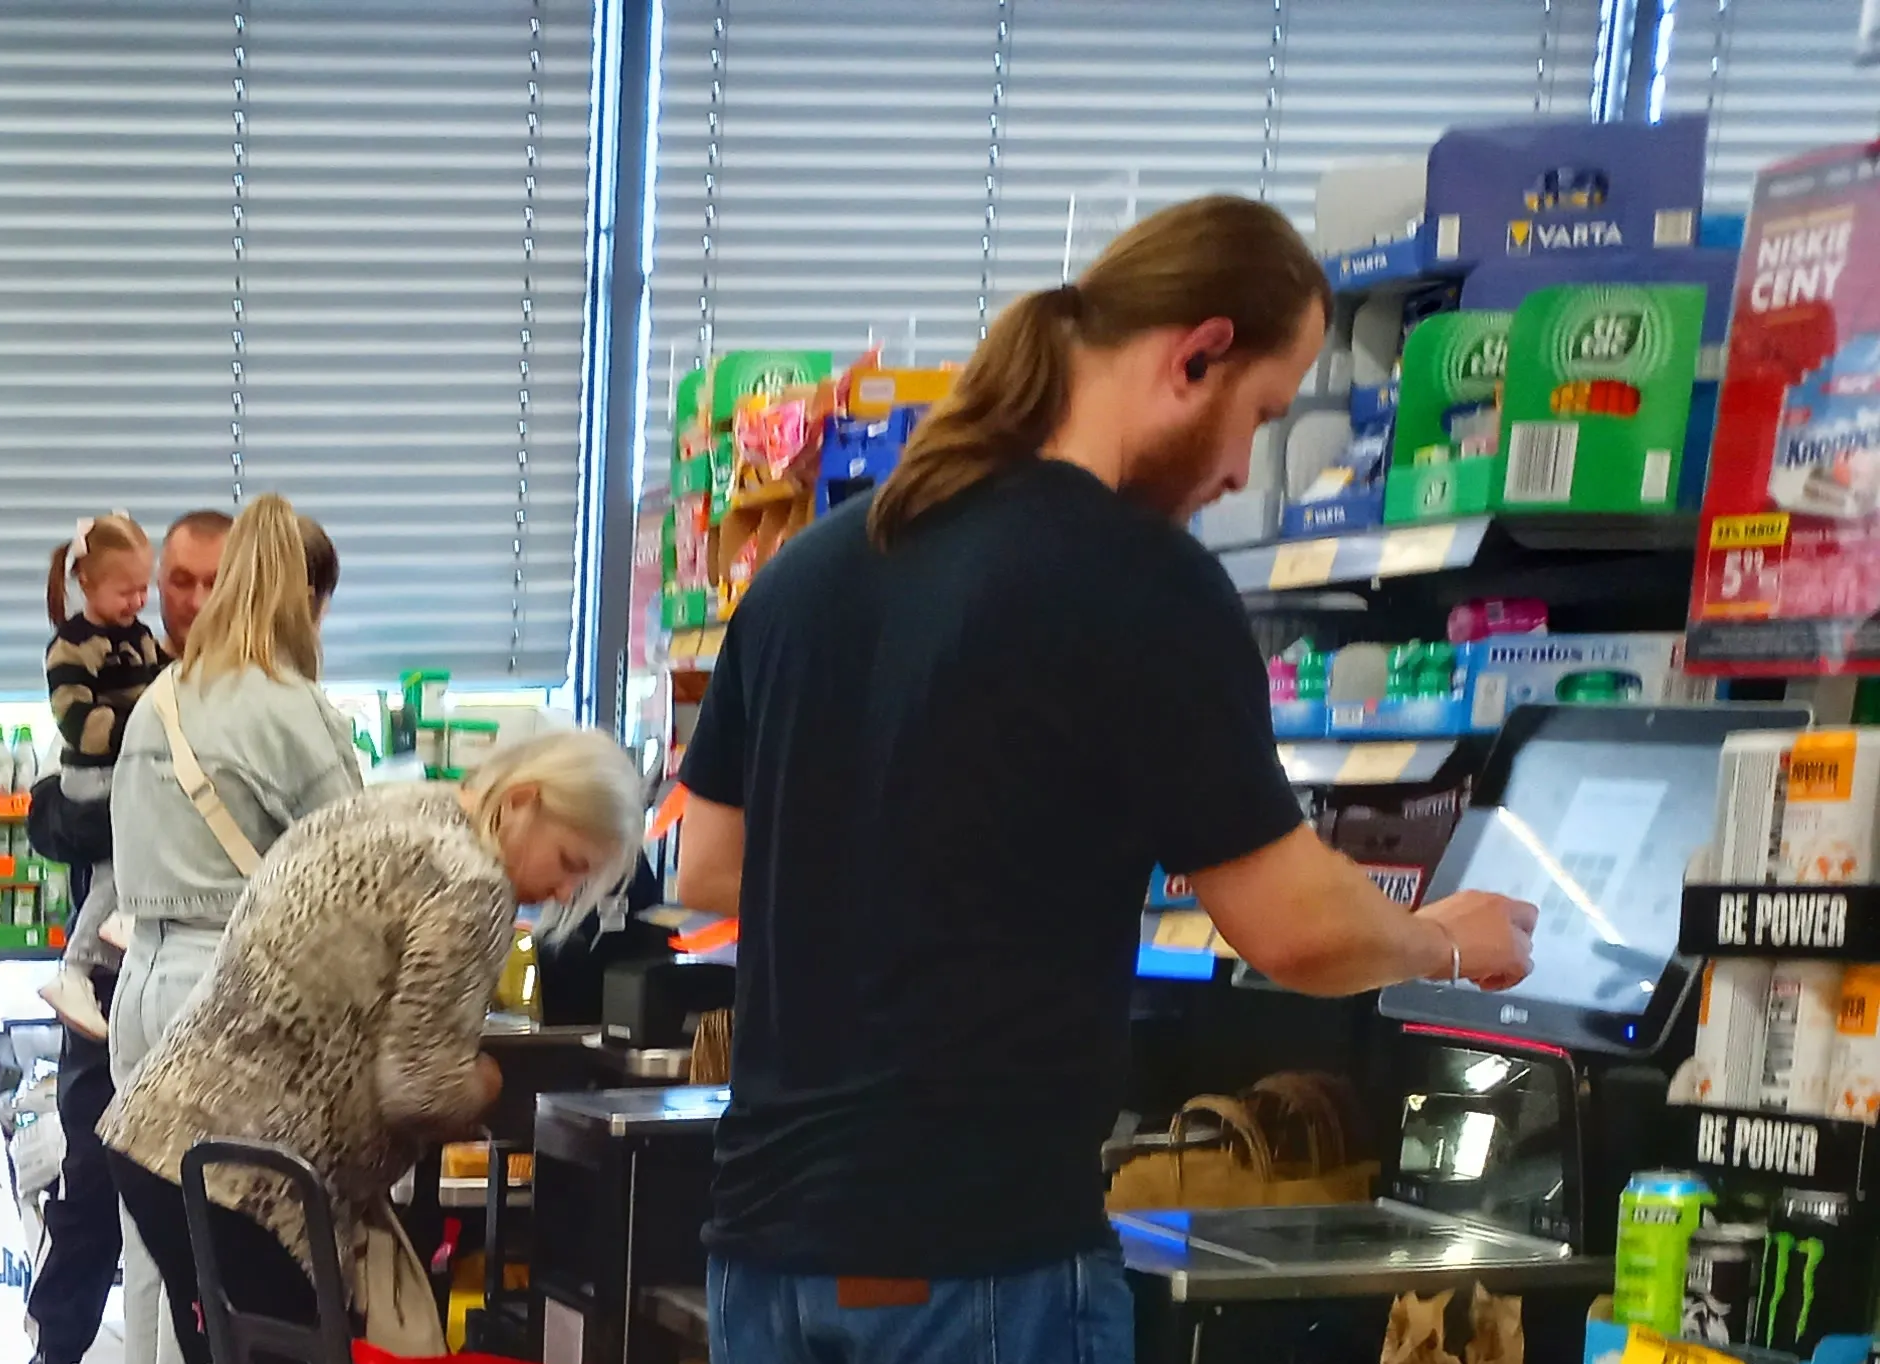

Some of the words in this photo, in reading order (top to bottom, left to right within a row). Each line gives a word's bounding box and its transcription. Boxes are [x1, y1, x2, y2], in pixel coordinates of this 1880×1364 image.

[1537, 221, 1622, 248] VARTA
[1750, 262, 1847, 314] CENY
[1721, 550, 1742, 598] 5
[1490, 646, 1582, 663] mentos
[1718, 892, 1749, 945] BE
[1754, 892, 1848, 948] POWER
[1697, 1112, 1728, 1165] BE
[1733, 1116, 1819, 1177] POWER
